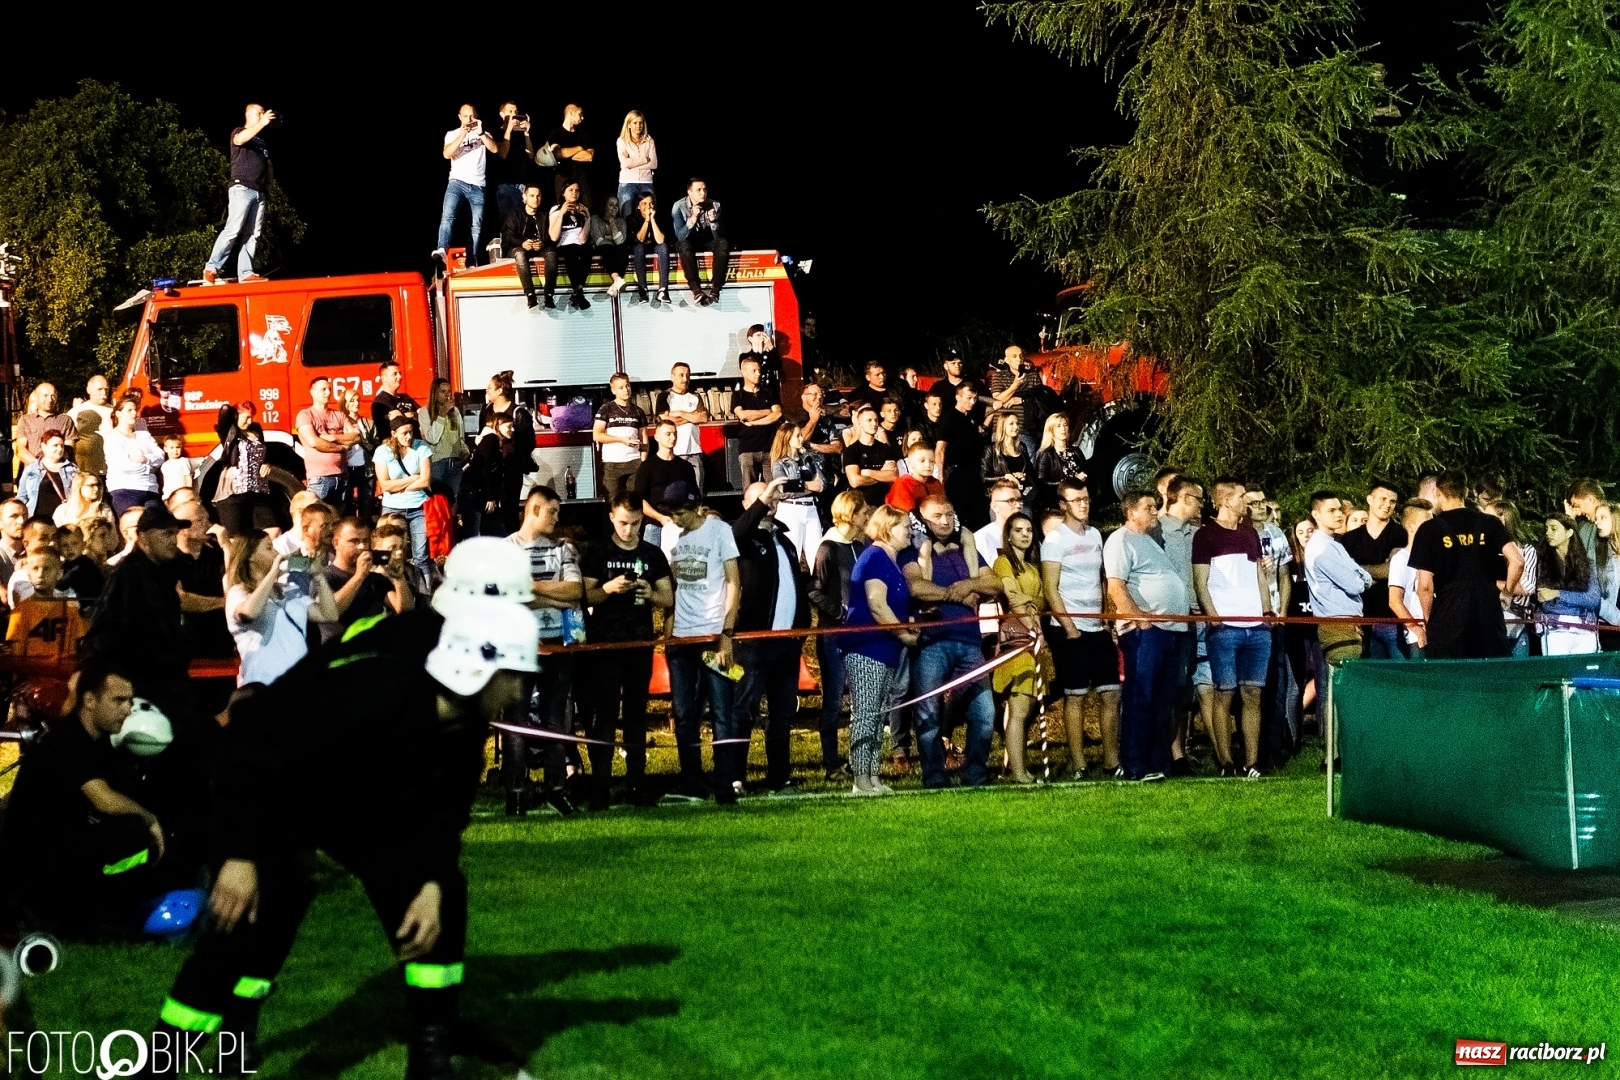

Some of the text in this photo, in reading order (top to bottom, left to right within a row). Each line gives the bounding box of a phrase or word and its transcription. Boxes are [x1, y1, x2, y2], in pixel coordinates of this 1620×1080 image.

[260, 388, 279, 400] 998
[328, 376, 360, 401] 67
[262, 411, 279, 423] 112
[27, 617, 69, 642] 4F
